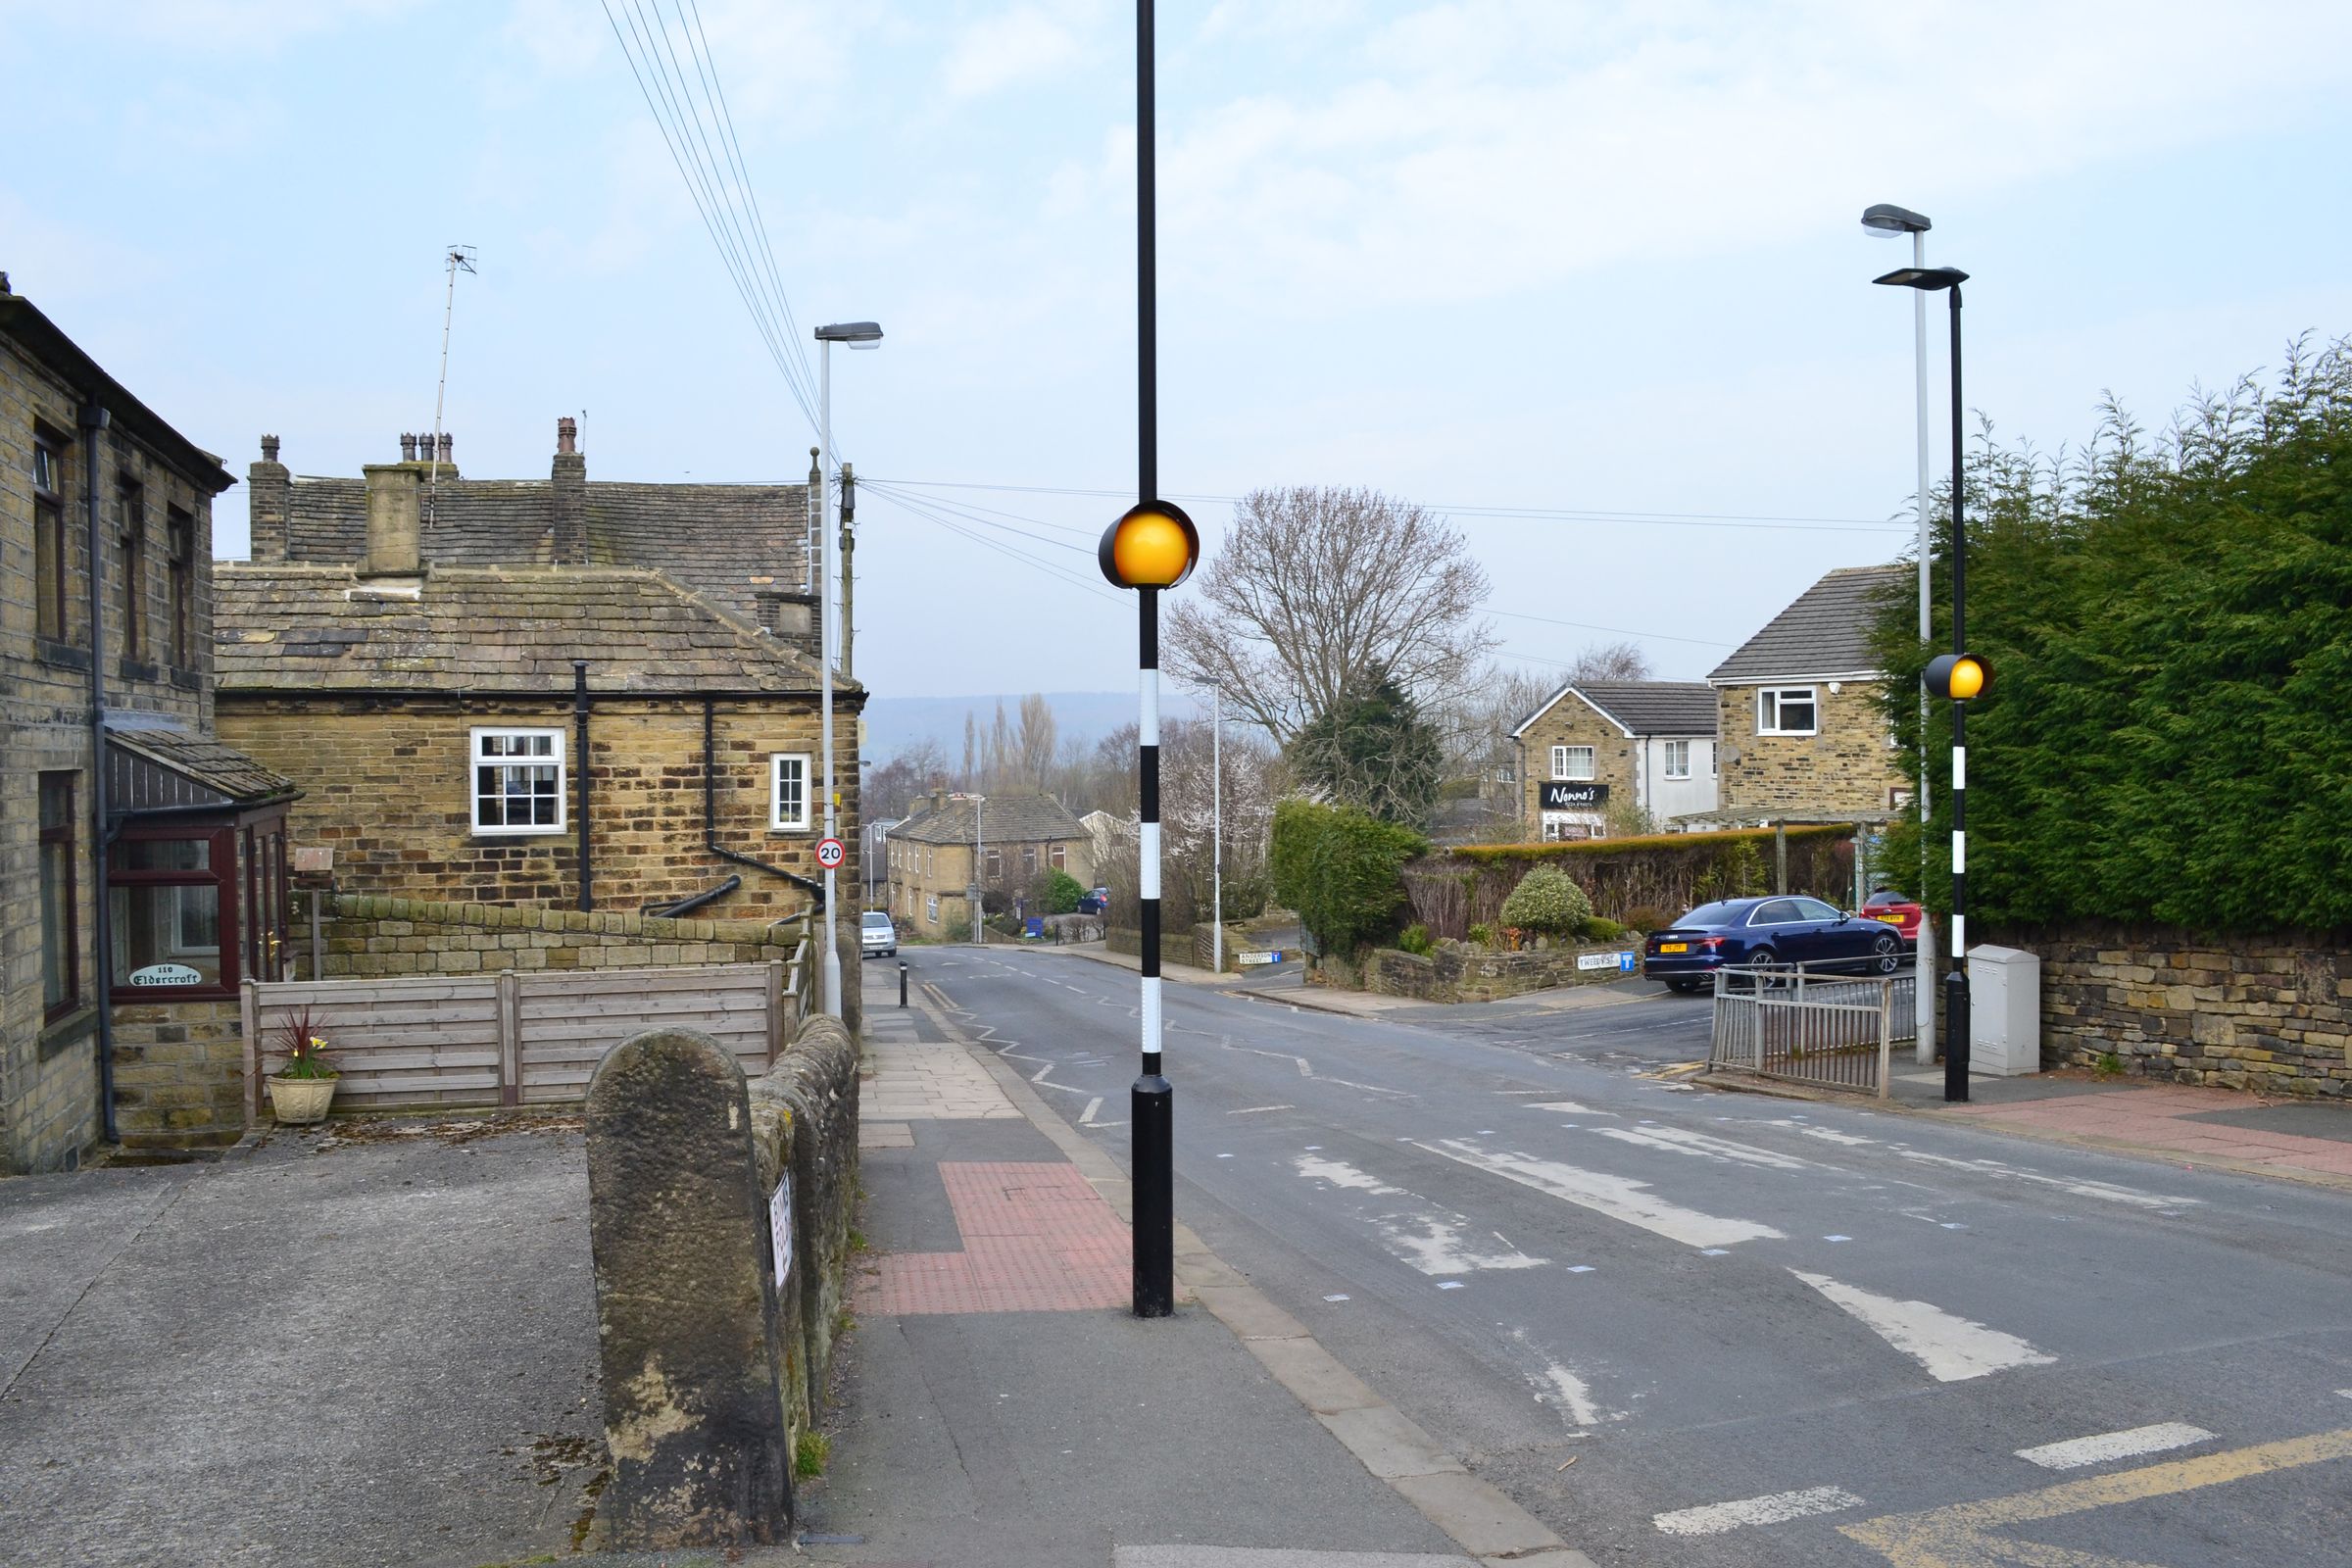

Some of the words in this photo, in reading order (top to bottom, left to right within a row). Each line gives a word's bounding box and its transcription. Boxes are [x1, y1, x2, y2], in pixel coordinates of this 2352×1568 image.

[1550, 787, 1595, 803] Nonno's
[821, 848, 841, 858] 20
[133, 974, 198, 985] Eldercroft
